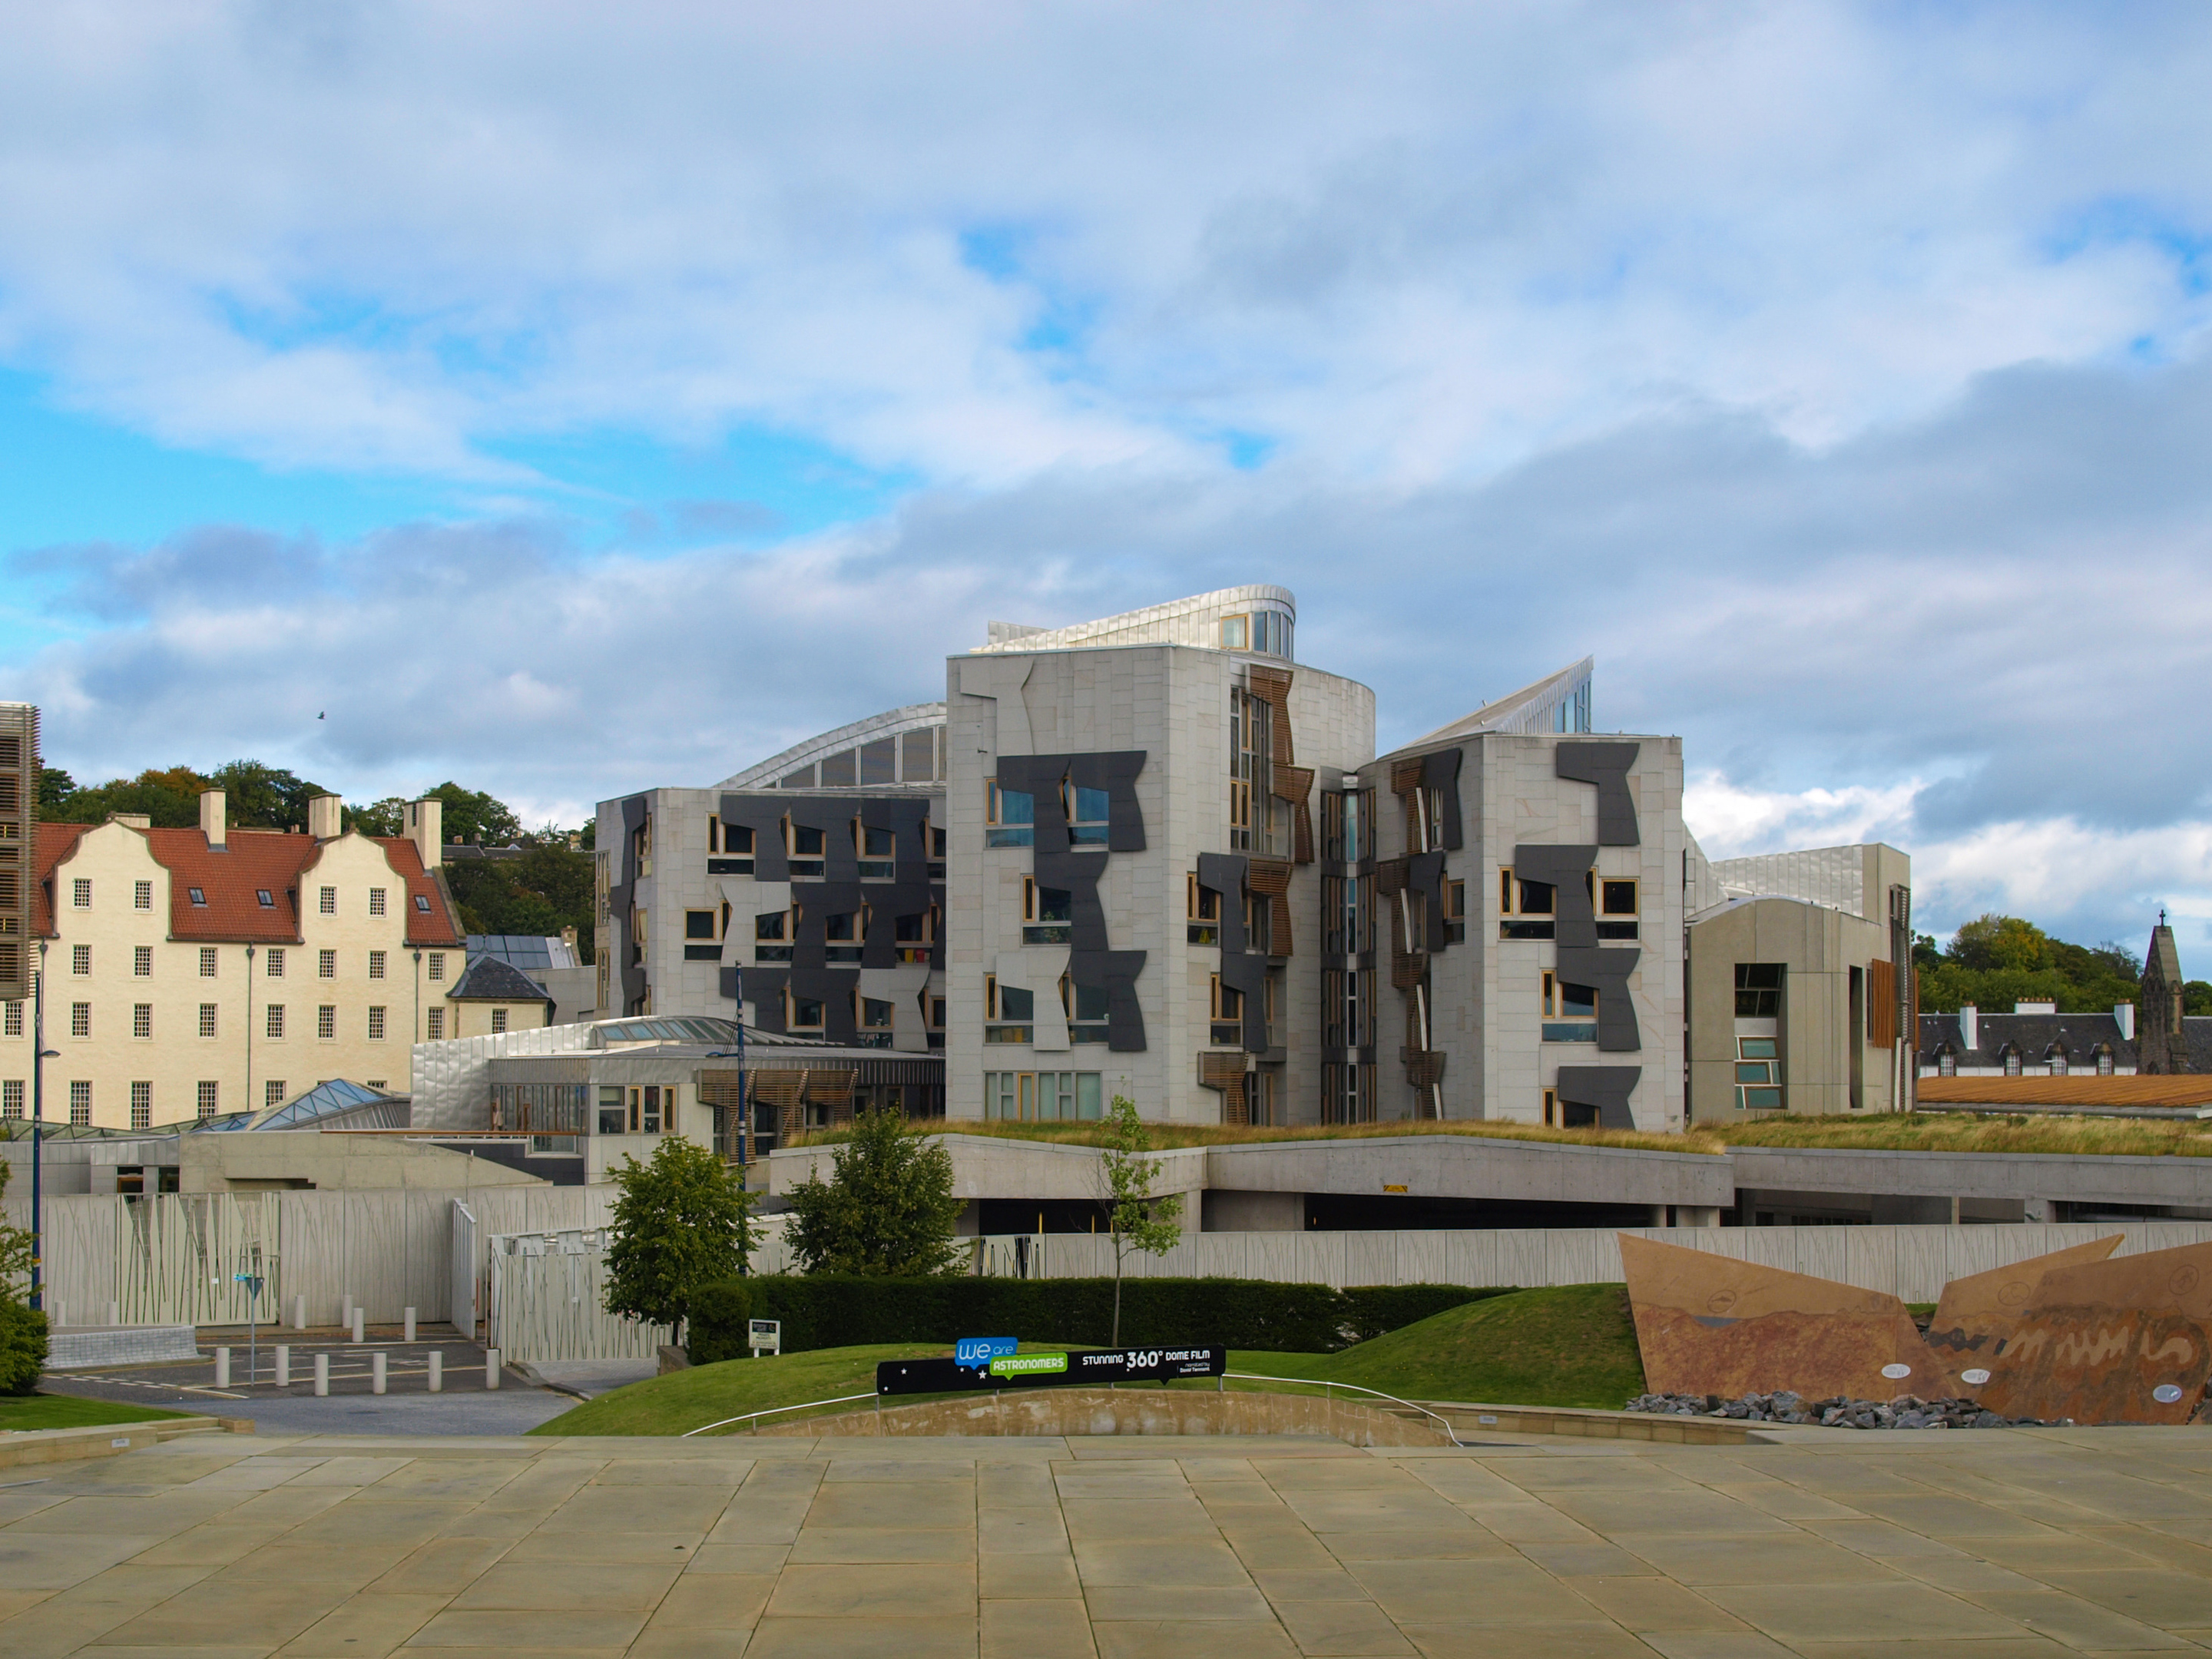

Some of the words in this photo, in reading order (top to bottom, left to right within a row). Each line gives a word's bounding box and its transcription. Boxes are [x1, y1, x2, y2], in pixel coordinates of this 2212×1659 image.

[993, 1346, 1014, 1355] are
[993, 1357, 1065, 1371] ASTRONOMERS
[1082, 1355, 1124, 1366] STUNNING
[1127, 1350, 1164, 1368] 360°
[1165, 1351, 1189, 1361] DOME
[1190, 1349, 1210, 1360] FILM
